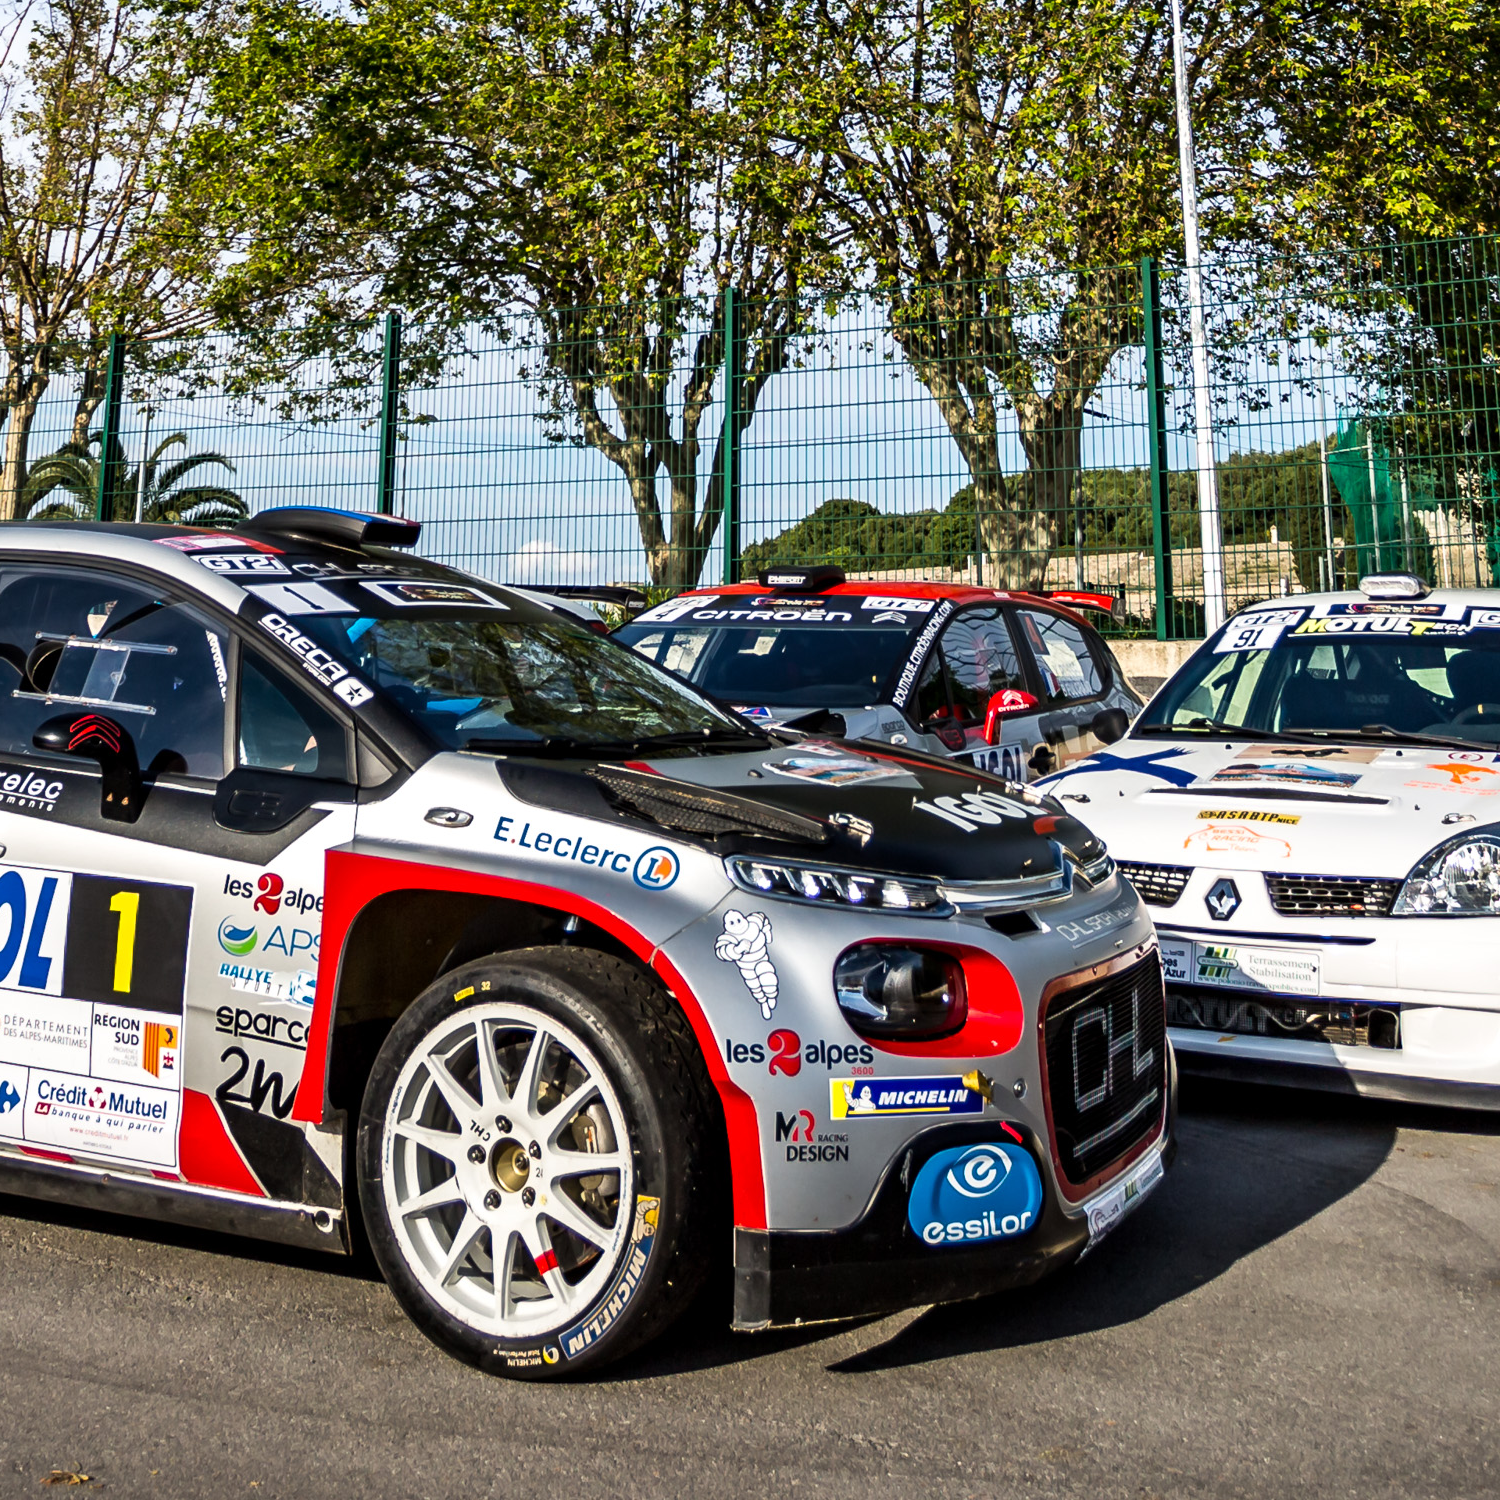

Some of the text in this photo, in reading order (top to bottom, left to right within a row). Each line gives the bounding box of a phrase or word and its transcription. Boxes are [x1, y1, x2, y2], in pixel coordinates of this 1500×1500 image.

[282, 585, 325, 611] 1
[1235, 610, 1300, 627] GT2i
[260, 613, 348, 680] ORECA
[1234, 628, 1260, 648] 91
[913, 791, 1048, 833] IGOL
[493, 815, 631, 874] E.Leclerc
[1211, 835, 1260, 844] RACING
[223, 872, 325, 916] les 2 alpe
[109, 890, 140, 993] 1
[219, 962, 273, 984] RALLYE
[1161, 966, 1186, 979] 'Azur
[1248, 954, 1313, 969] Terrassement
[1249, 966, 1312, 981] Stabilisation
[480, 980, 491, 991] 32
[3, 1013, 89, 1037] DÉPARTEMENT
[94, 1012, 140, 1032] RÉGION
[215, 1005, 311, 1045] sparc
[3, 1026, 88, 1049] DES ALPES-MARITIMES
[114, 1031, 140, 1046] SUD
[726, 1028, 874, 1078] les 2 alpes
[1071, 987, 1155, 1113] CHL
[850, 1066, 875, 1076] 3600
[37, 1079, 168, 1120] Crédit Mutuel
[878, 1088, 969, 1106] MICHELIN
[51, 1106, 91, 1121] banque
[95, 1114, 101, 1124] à
[106, 1117, 124, 1127] qui
[127, 1121, 165, 1134] parler
[469, 1119, 491, 1142] CHL
[775, 1109, 816, 1142] MR
[817, 1133, 849, 1143] RACING
[786, 1145, 849, 1162] DESIGN
[922, 1210, 1032, 1245] essilor
[568, 1250, 647, 1356] MICHELIN
[507, 1357, 542, 1367] MICHELIN
